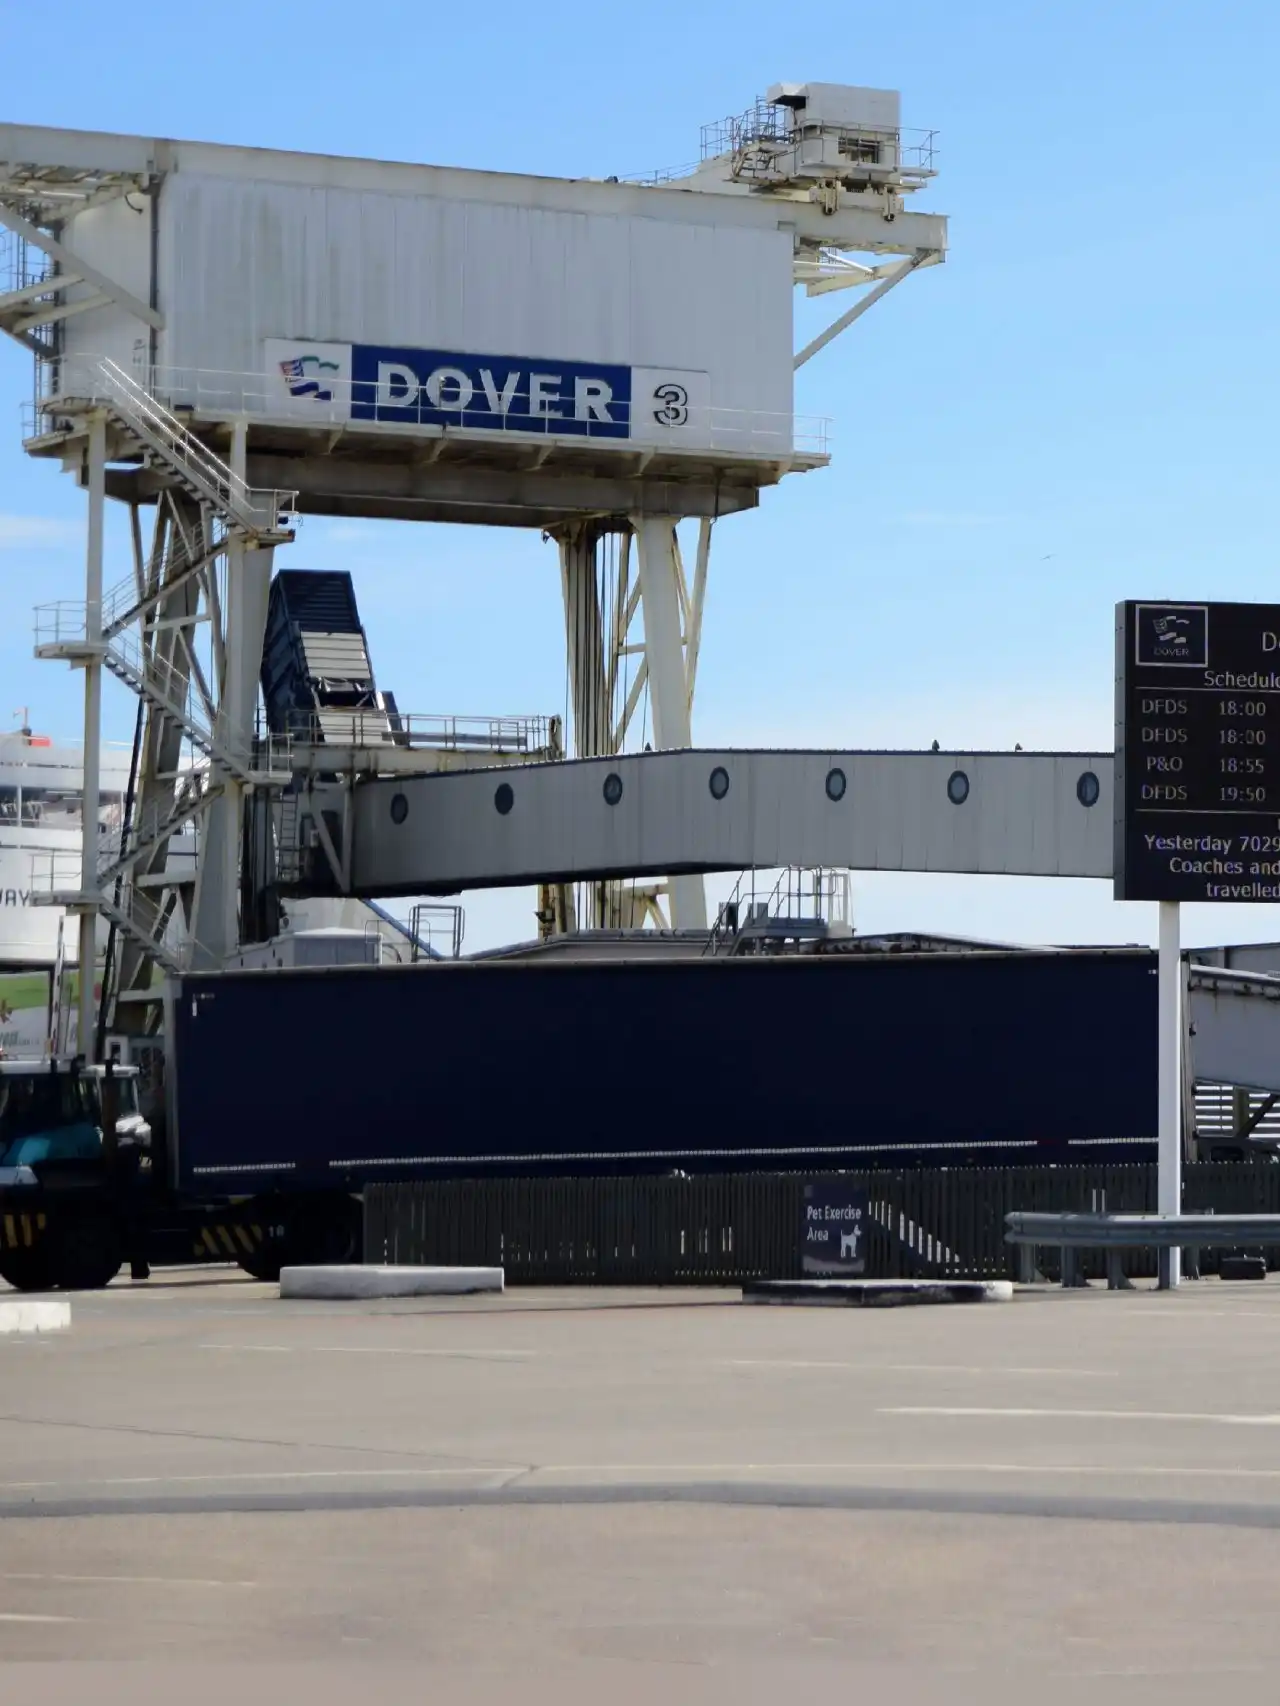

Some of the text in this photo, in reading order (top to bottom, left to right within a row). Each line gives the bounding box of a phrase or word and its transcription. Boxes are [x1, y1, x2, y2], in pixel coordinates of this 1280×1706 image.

[378, 361, 689, 427] DOVER 3
[1153, 646, 1189, 657] DOVER
[1142, 699, 1187, 715] DFDS
[1219, 701, 1266, 717] 18:00
[1142, 727, 1187, 743] DFDS
[1146, 756, 1183, 772] P&O
[1220, 759, 1265, 774] 18:55
[1142, 785, 1187, 801] DFDS
[1219, 787, 1266, 802] 19:50
[1144, 834, 1232, 855] Yesterday
[1170, 858, 1243, 875] Coaches
[807, 1204, 861, 1220] Pet Exercise
[807, 1226, 829, 1241] Area
